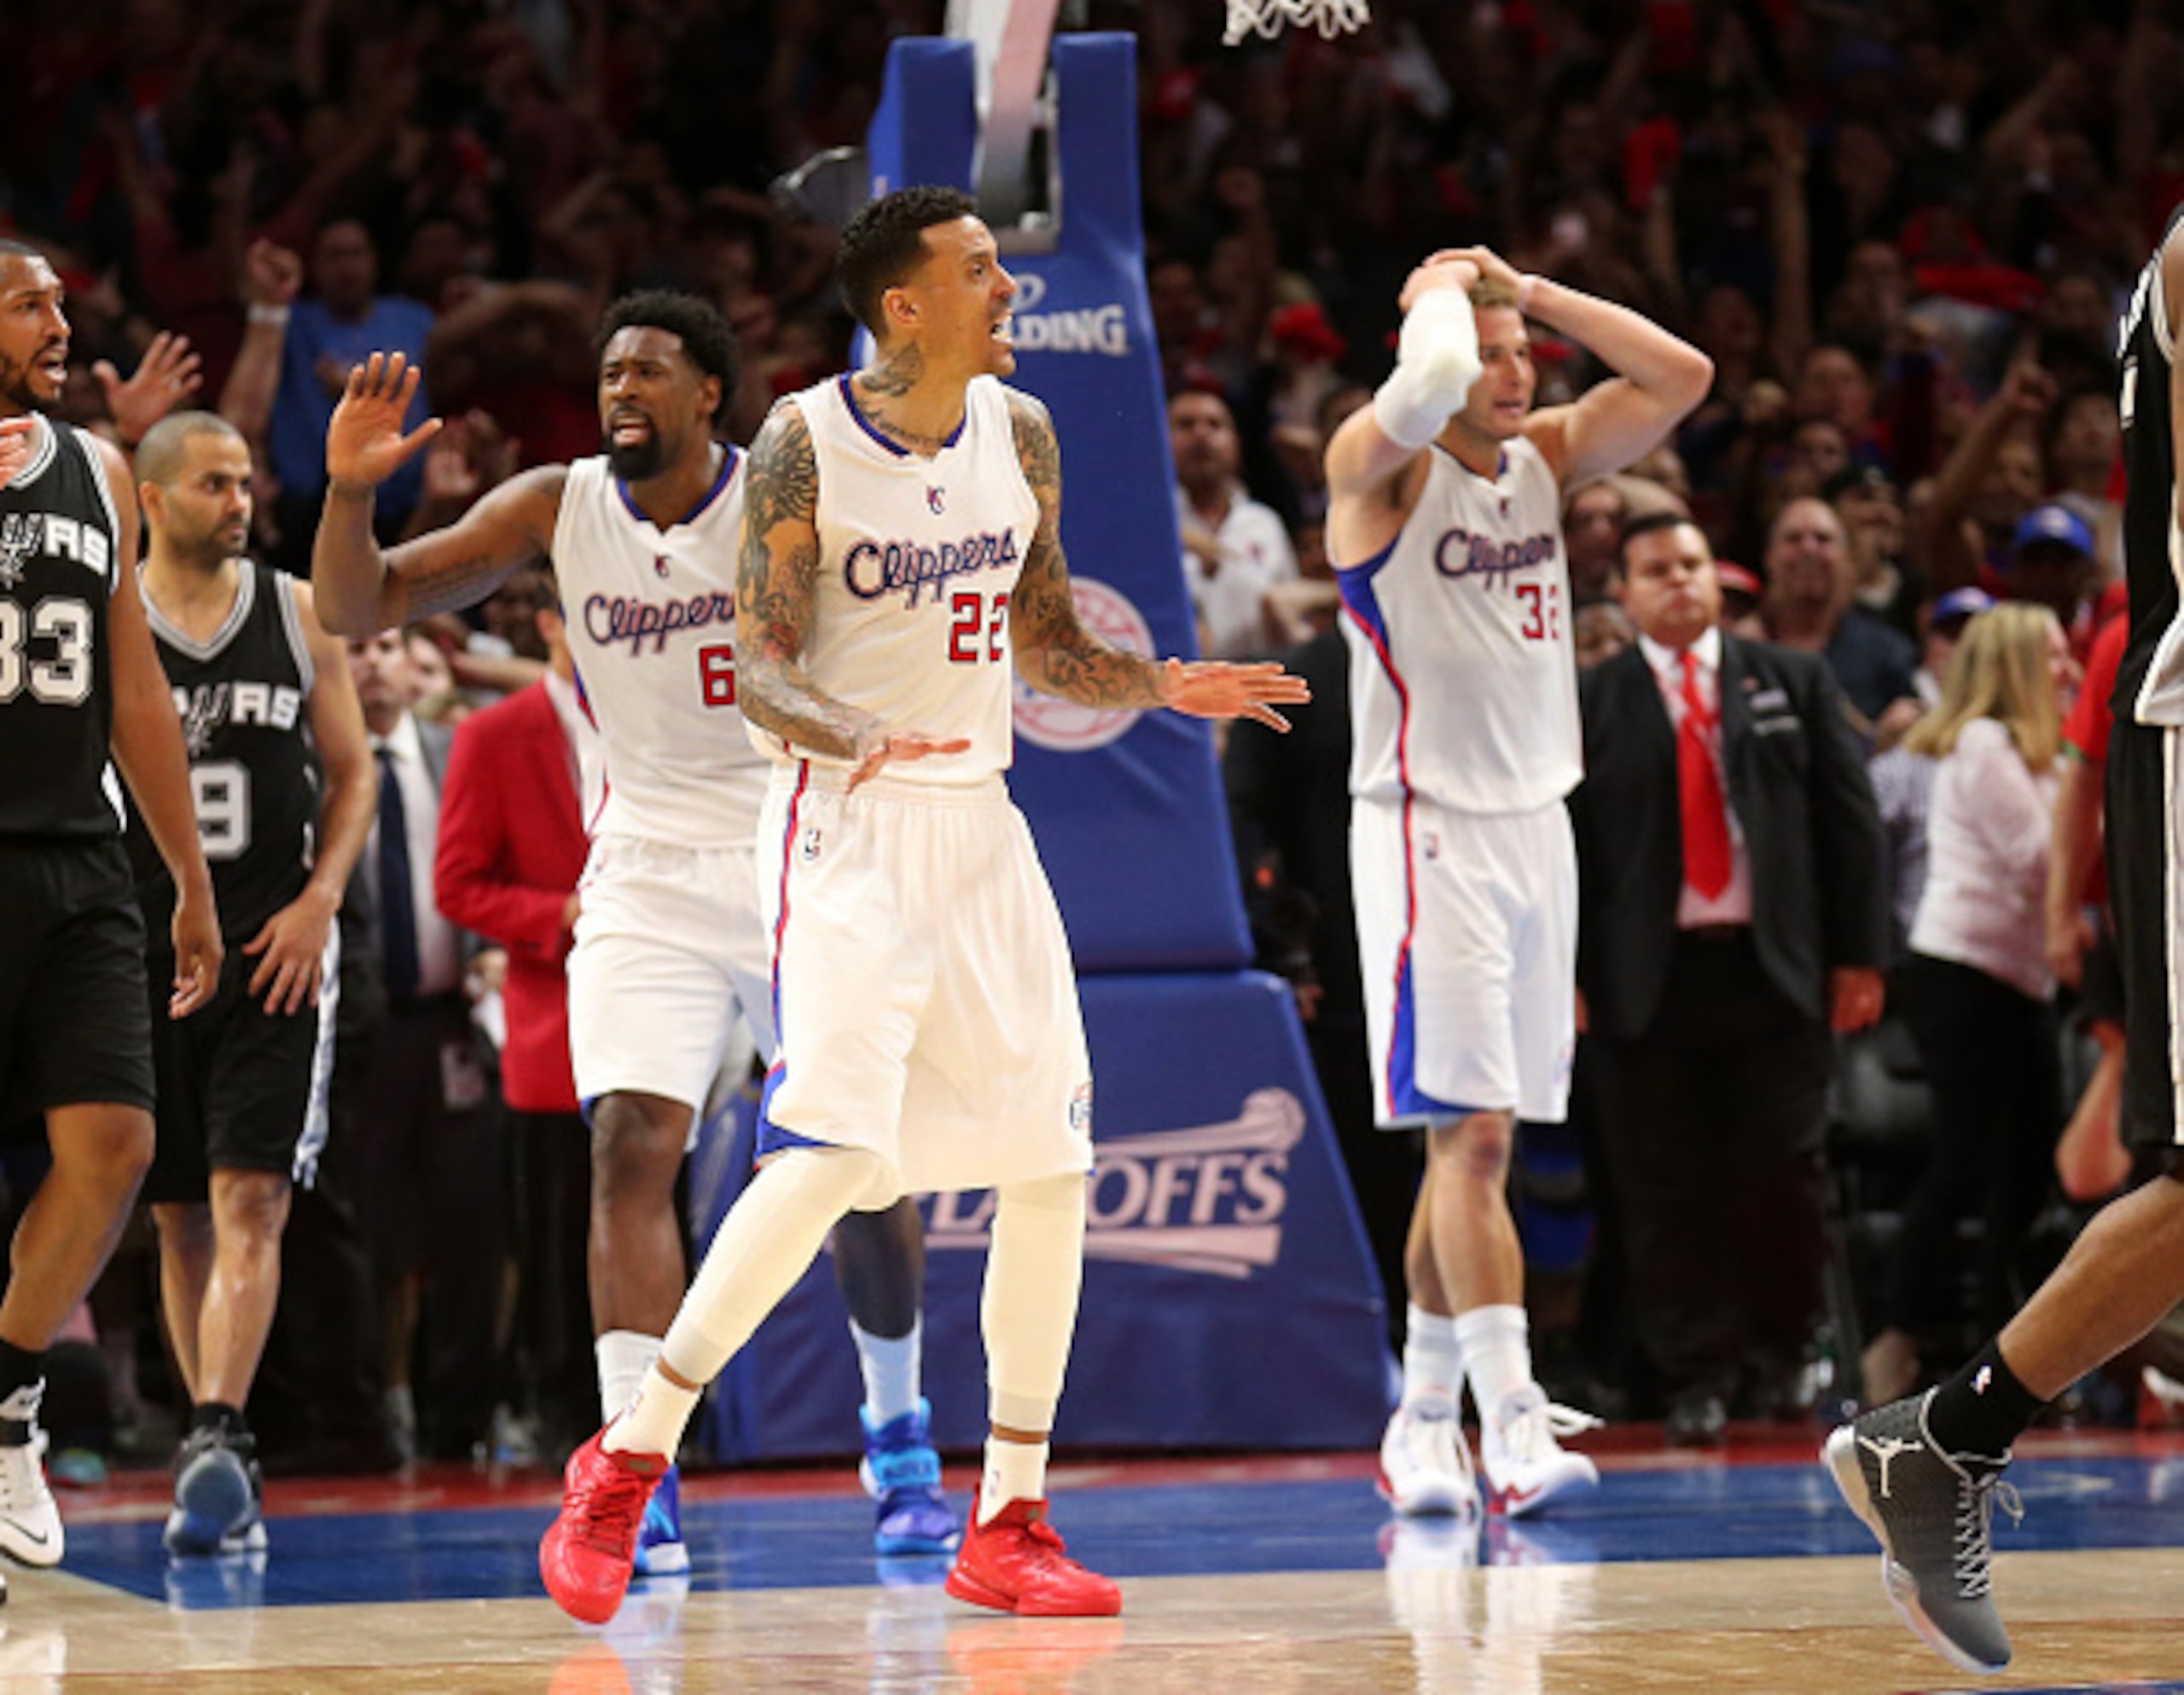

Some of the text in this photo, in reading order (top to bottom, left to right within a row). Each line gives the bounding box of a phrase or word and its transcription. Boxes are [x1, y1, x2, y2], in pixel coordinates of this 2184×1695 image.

[1003, 304, 1129, 357] LDING
[842, 522, 1019, 611] Clippers
[1434, 527, 1555, 591] Clipper
[584, 590, 735, 658] Clipper
[700, 644, 735, 706] 6
[189, 762, 252, 859] 9
